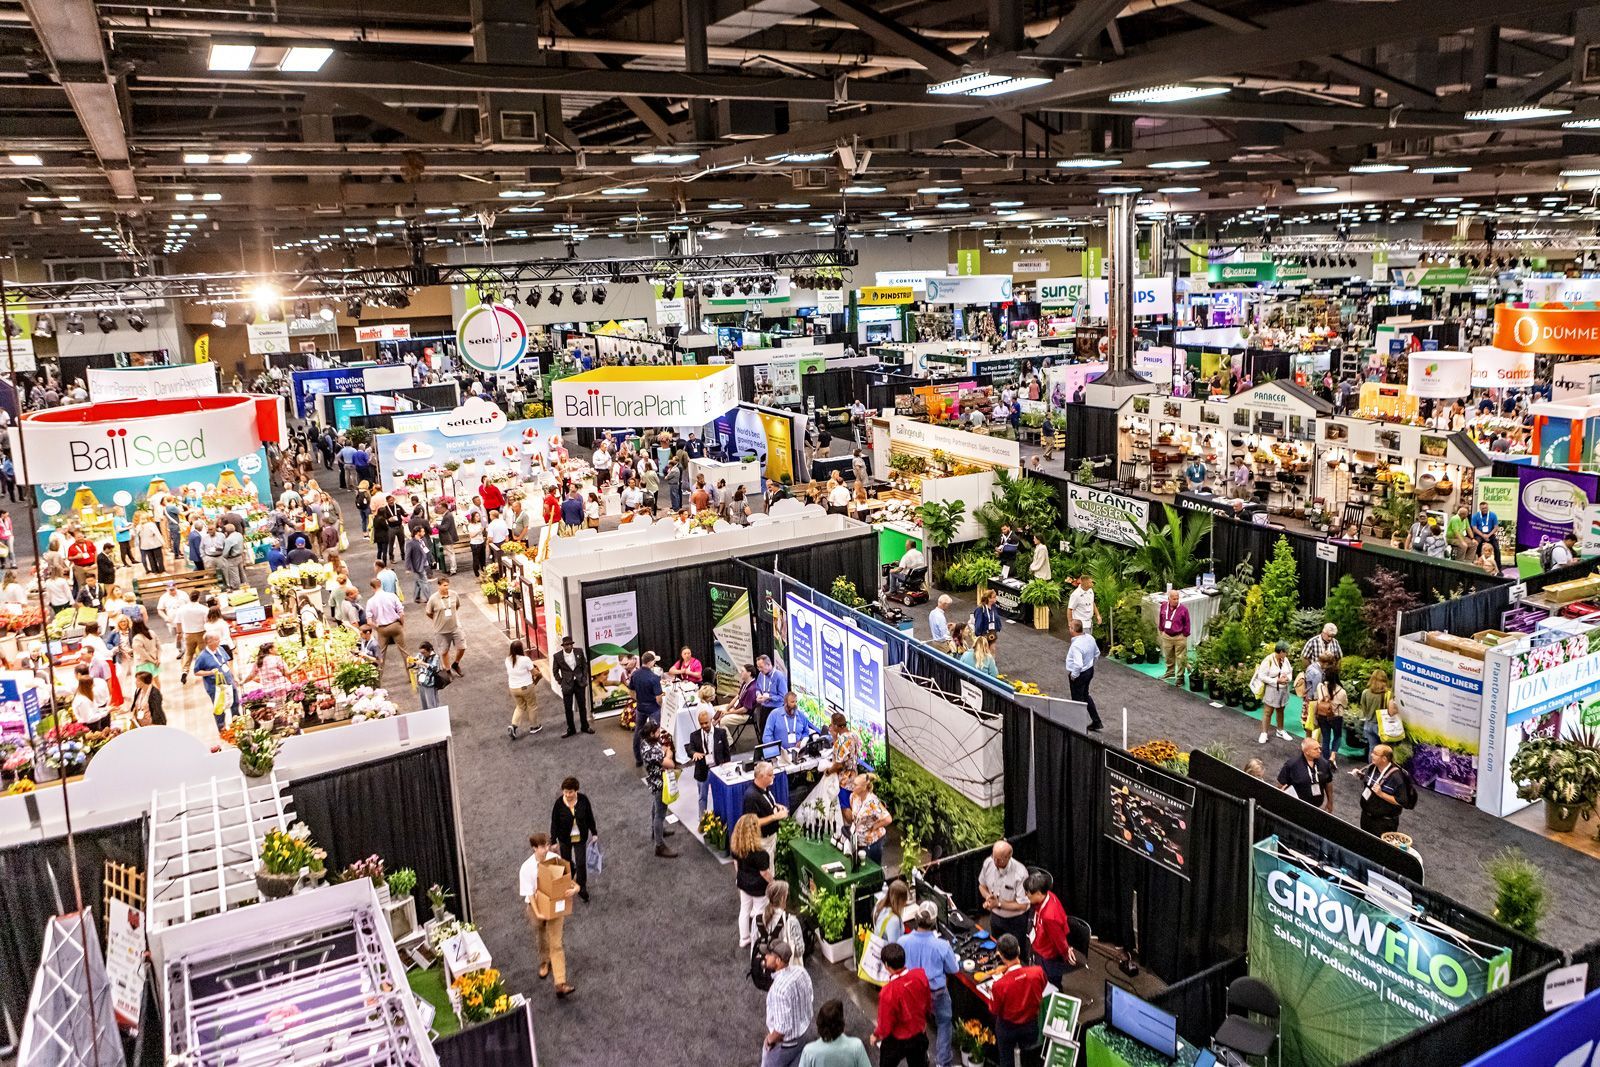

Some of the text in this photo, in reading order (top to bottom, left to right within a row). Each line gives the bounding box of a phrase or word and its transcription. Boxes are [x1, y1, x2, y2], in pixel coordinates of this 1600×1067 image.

[880, 292, 912, 300] PINDSTRUP
[1104, 290, 1155, 306] PIPS
[360, 328, 383, 340] lambert
[1143, 356, 1163, 364] PHILIPS
[1136, 370, 1153, 378] HILIPS
[335, 376, 365, 387] Dilution
[1254, 391, 1286, 403] PANACEA
[446, 415, 493, 428] selecta
[132, 427, 207, 466] Seed
[1483, 486, 1511, 498] Nursery
[1483, 494, 1503, 502] Guide
[1088, 490, 1144, 519] PLANTS
[1534, 495, 1574, 508] FARWEST
[595, 628, 613, 641] H-2A
[859, 664, 870, 675] Cloud
[1458, 661, 1482, 675] Sunset
[1400, 676, 1425, 688] AVAILABLE
[1426, 683, 1439, 692] NOW
[1401, 661, 1480, 694] TOP BRANDED LINERS
[1513, 672, 1550, 711] JOIN
[1487, 661, 1502, 773] PlantDevelopment.com
[1110, 771, 1132, 787] HISTORY
[1166, 797, 1186, 812] SERIES
[1268, 901, 1293, 925] Cloud
[1294, 917, 1349, 954] Greenhouse
[1350, 945, 1415, 993] Management
[1273, 923, 1303, 950] Sales
[1309, 945, 1378, 996] Production
